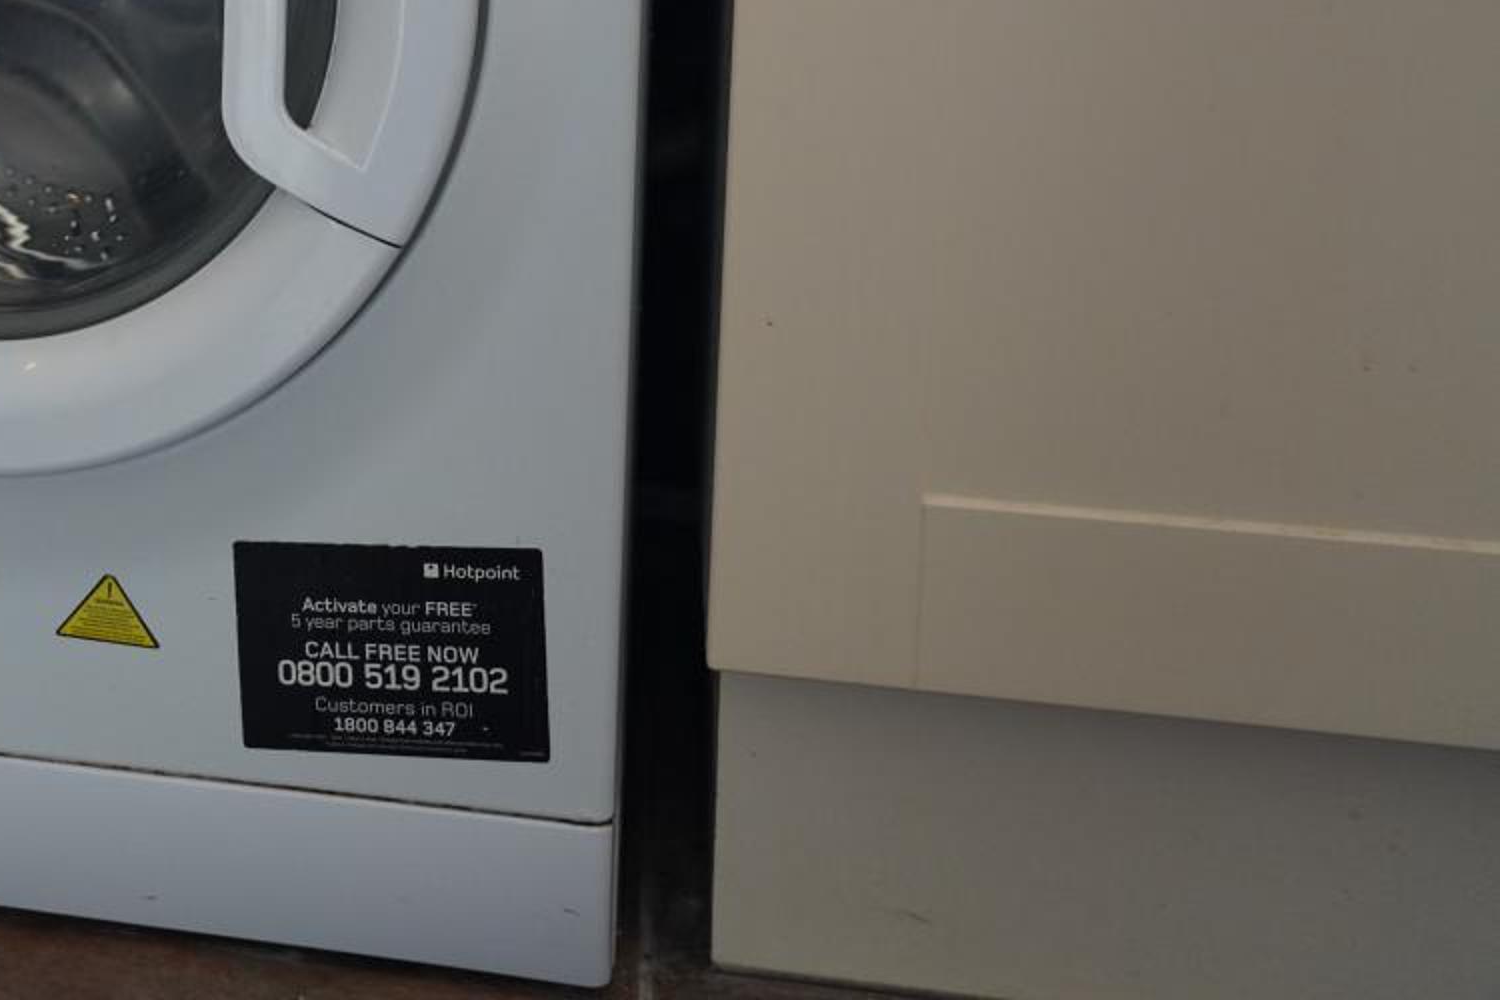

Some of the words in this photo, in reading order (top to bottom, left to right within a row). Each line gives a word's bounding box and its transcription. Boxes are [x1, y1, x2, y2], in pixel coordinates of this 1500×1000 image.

[443, 564, 521, 583] Hotpoint
[302, 597, 378, 615] Activate
[381, 603, 421, 617] your
[291, 613, 302, 629] 5
[304, 617, 343, 634] year
[348, 618, 395, 634] parts
[401, 621, 491, 637] guarantee
[305, 641, 360, 661] CALL
[364, 643, 421, 662] FREE
[427, 646, 479, 664] NOW
[277, 659, 354, 688] 0800
[364, 663, 421, 691] 519
[431, 666, 509, 695] 2102
[315, 697, 415, 716] Customers
[421, 701, 436, 716] in
[441, 703, 473, 719] ROI
[334, 717, 379, 733] 1800
[383, 719, 417, 735] 844
[422, 721, 455, 737] 347
